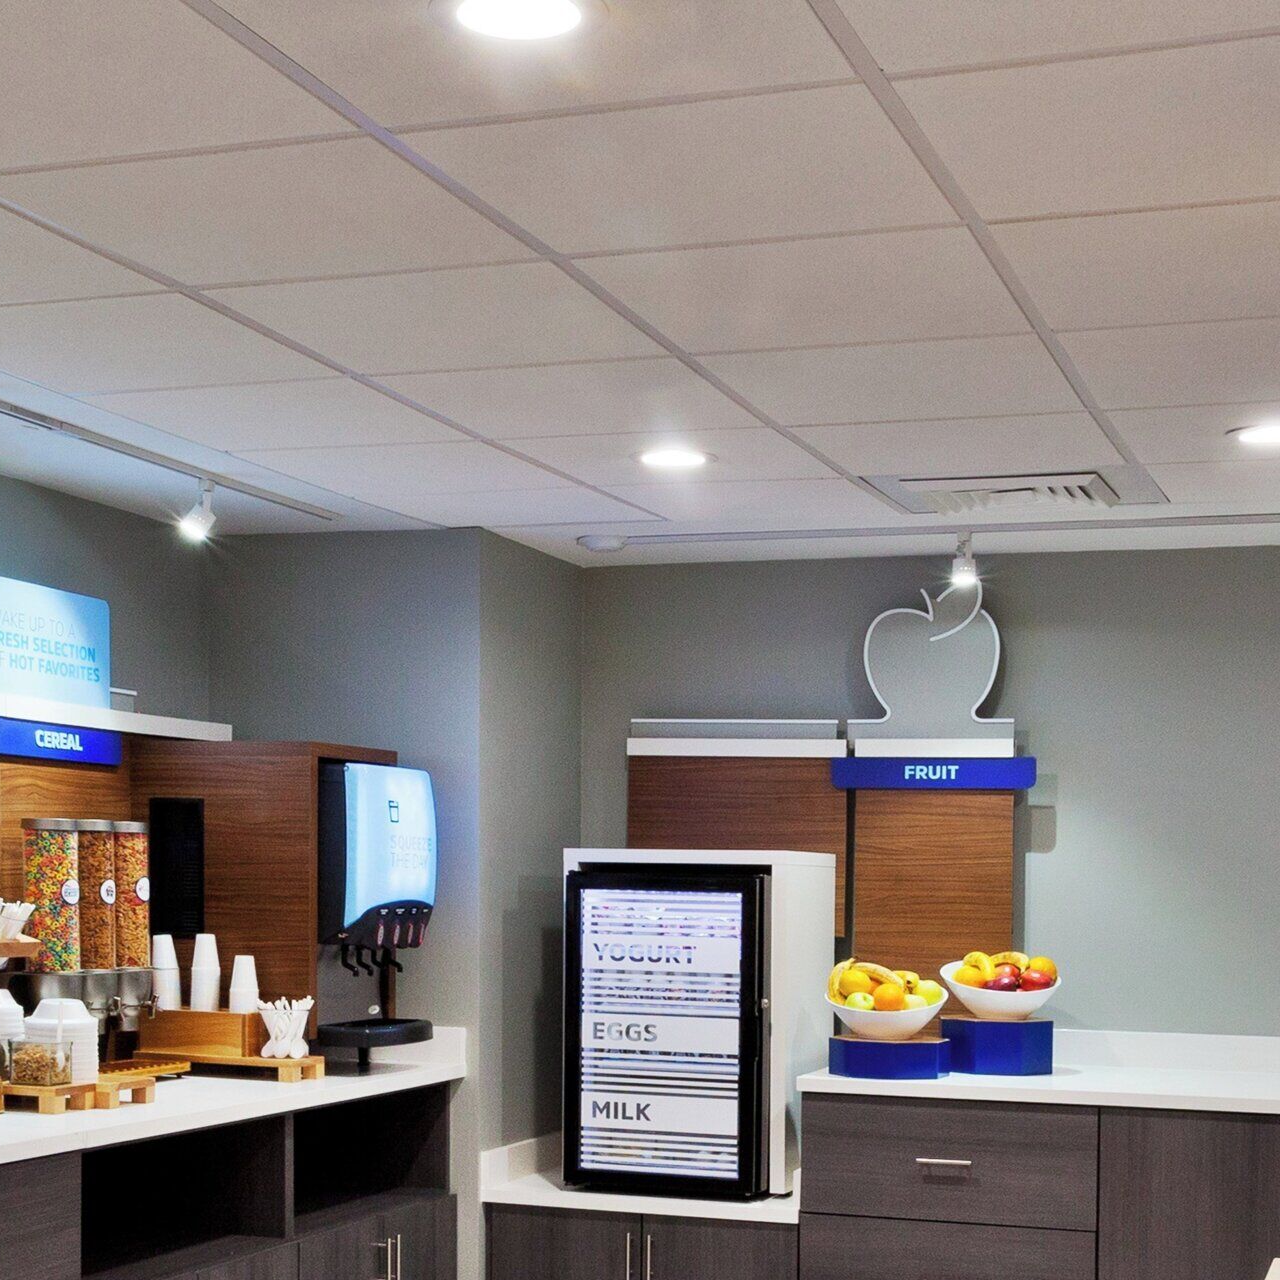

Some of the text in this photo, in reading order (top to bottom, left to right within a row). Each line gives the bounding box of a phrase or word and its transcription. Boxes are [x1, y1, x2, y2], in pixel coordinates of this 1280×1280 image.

[29, 615, 46, 633] UP
[49, 619, 64, 637] TO
[33, 637, 96, 663] SELECTION
[9, 653, 34, 672] HOT
[38, 658, 100, 682] FAVORITES
[34, 729, 84, 752] CEREAL
[904, 765, 960, 780] FRUIT
[593, 943, 697, 964] YOGURT
[592, 1021, 658, 1042] EGGS
[592, 1100, 652, 1121] MILK
